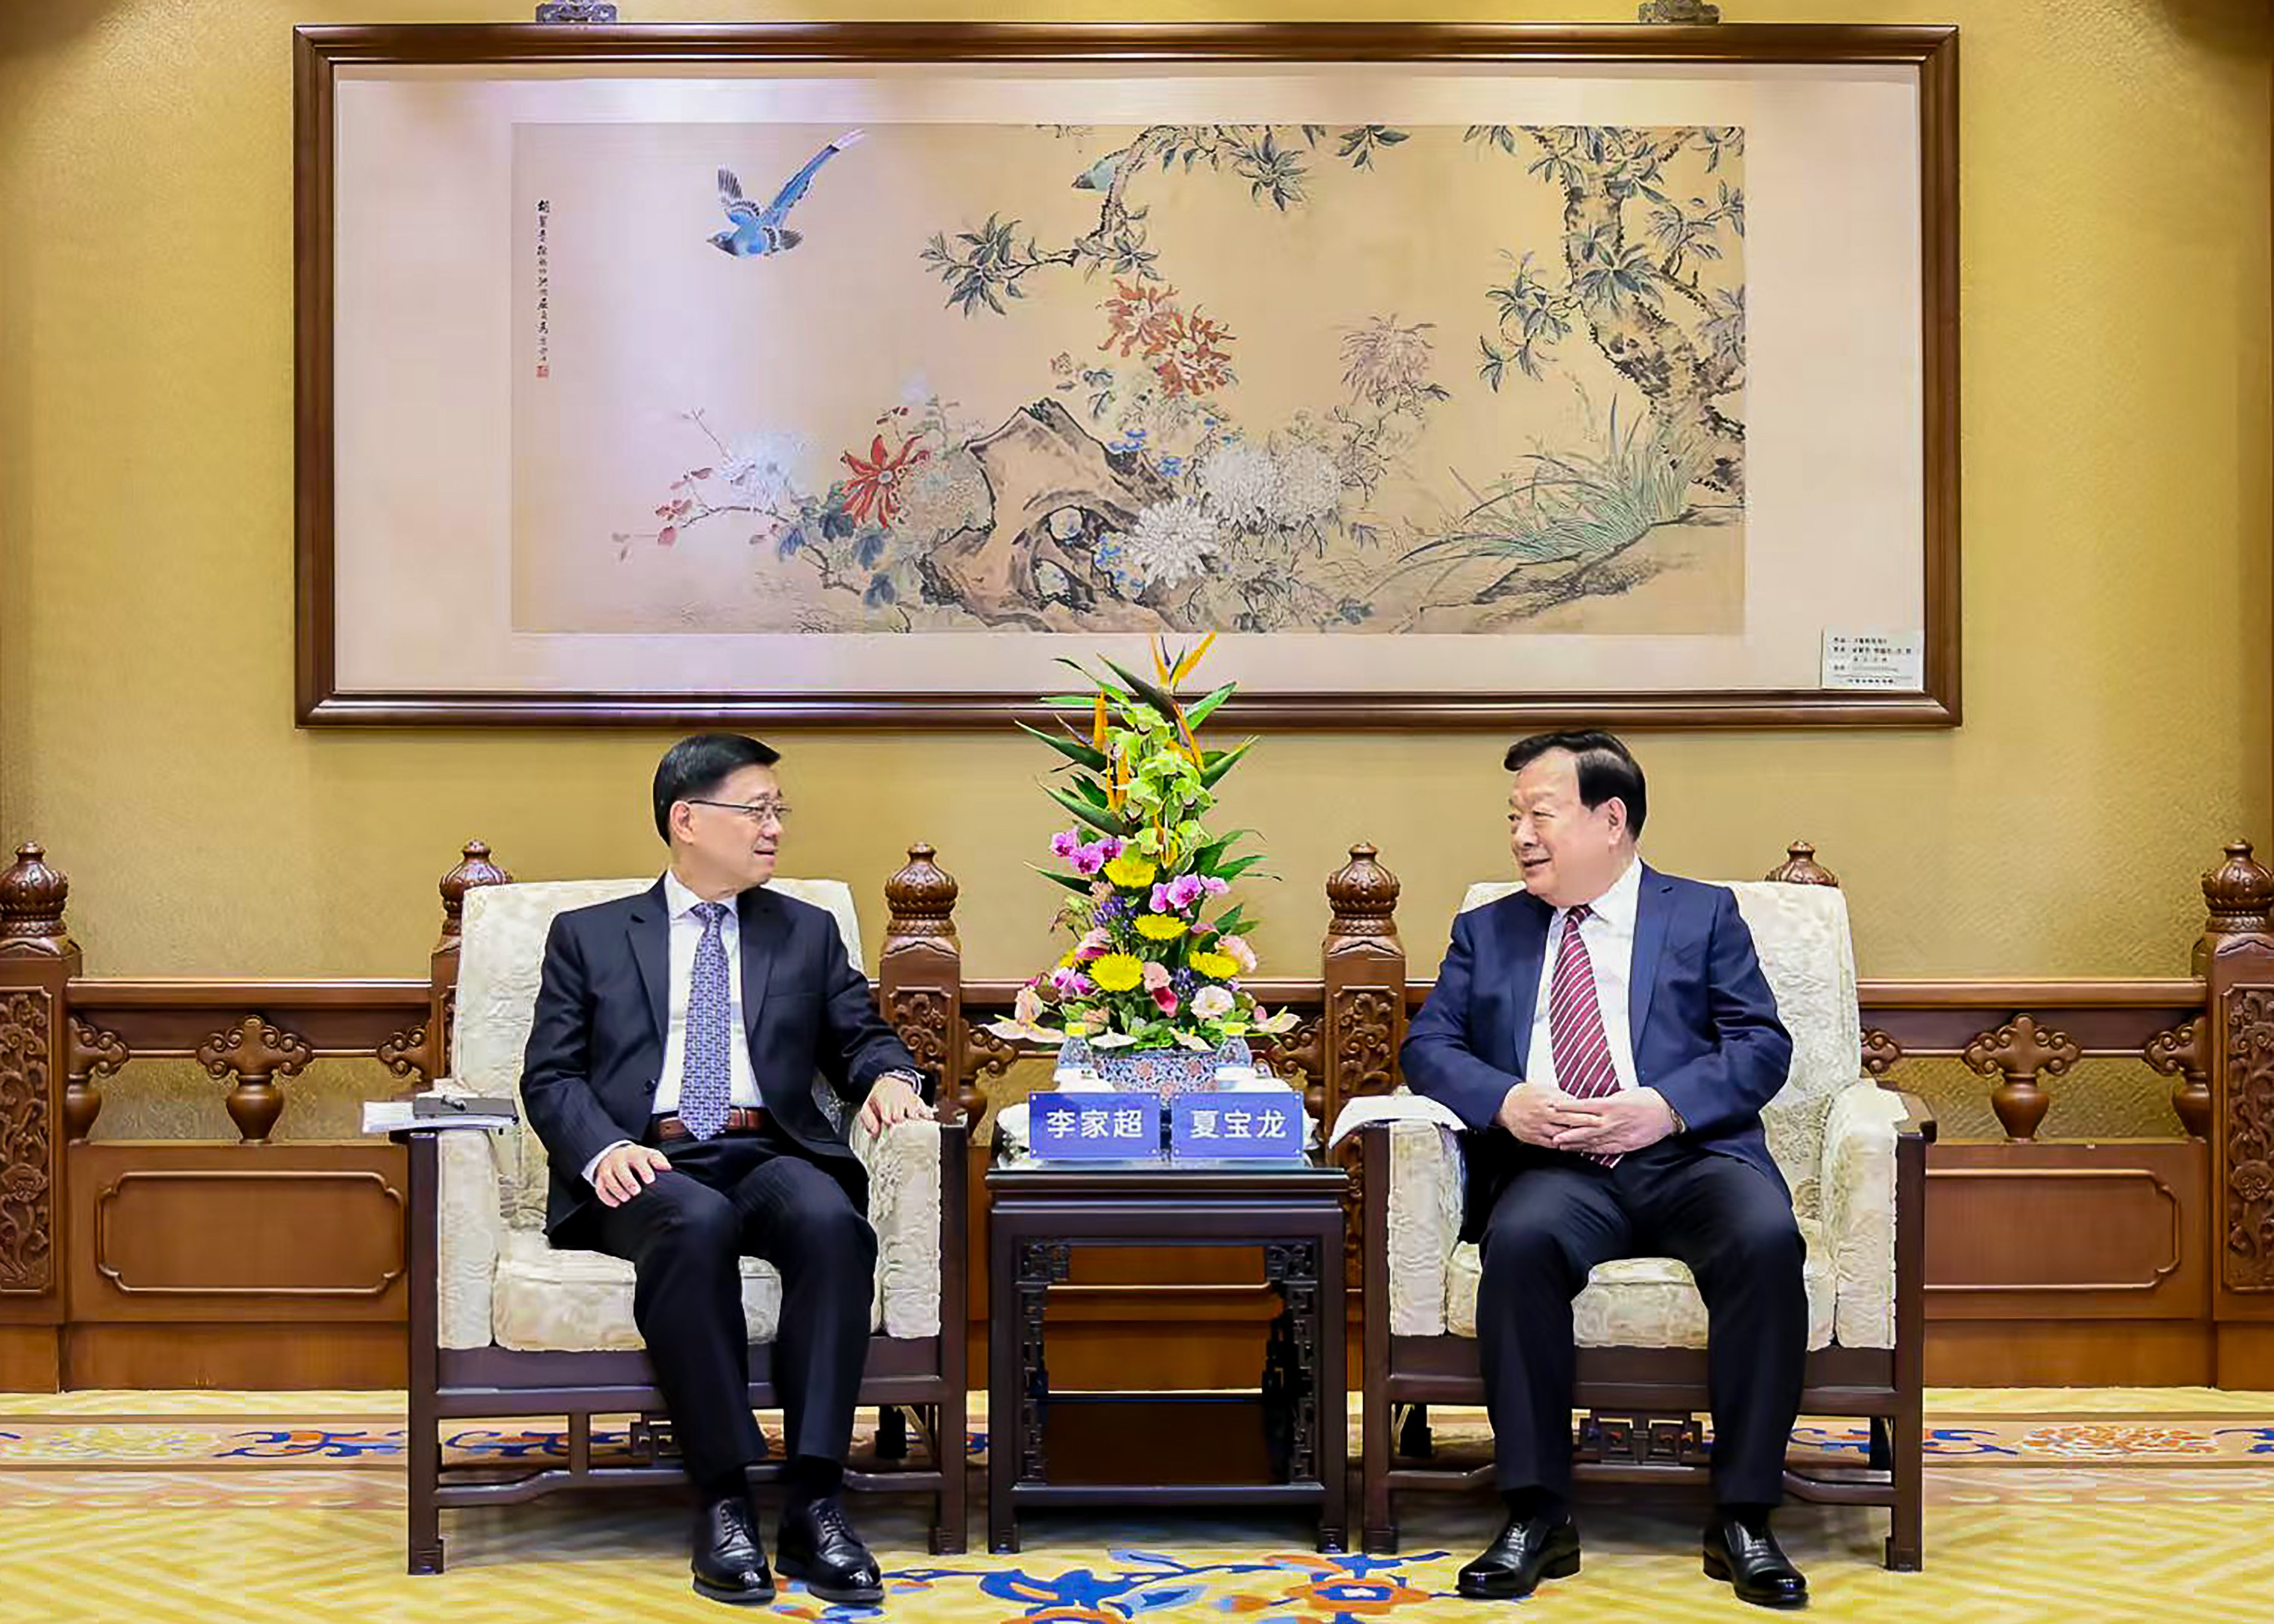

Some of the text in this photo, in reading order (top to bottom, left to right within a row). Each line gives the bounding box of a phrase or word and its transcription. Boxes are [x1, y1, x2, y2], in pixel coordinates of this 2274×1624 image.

[1047, 1109, 1143, 1139] 李家超
[1190, 1109, 1287, 1139] 夏宝龙
